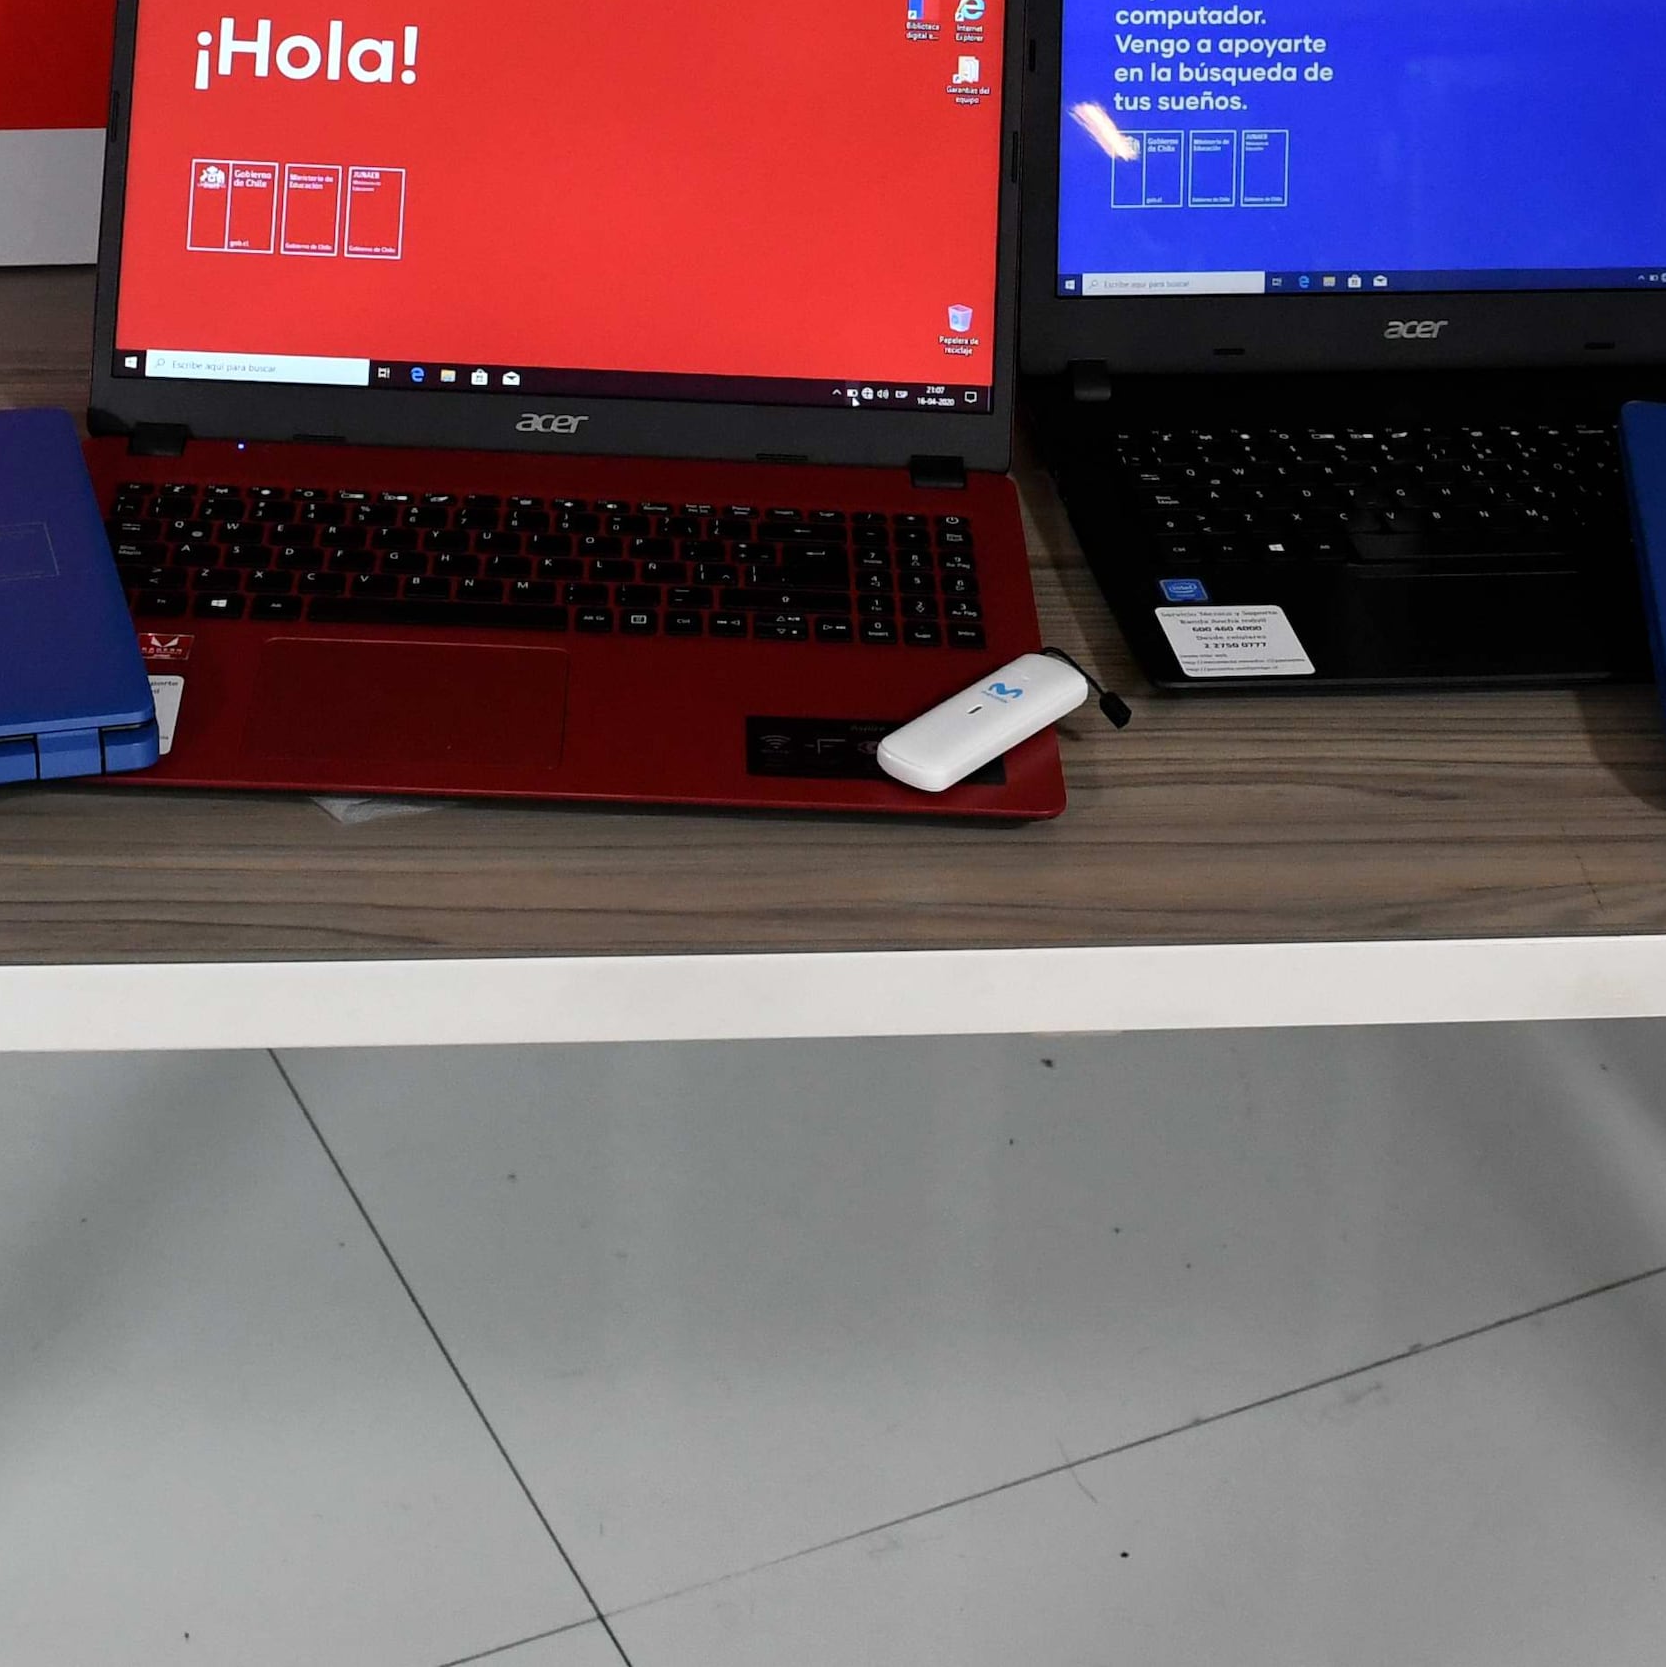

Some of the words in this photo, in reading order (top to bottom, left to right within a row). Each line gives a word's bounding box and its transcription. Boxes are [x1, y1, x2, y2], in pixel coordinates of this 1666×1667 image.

[1115, 5, 1266, 29] computador.
[906, 22, 940, 30] Biblioteca
[957, 24, 983, 32] Internet
[956, 34, 983, 42] Explorer
[1114, 34, 1190, 58] Vengo
[1196, 38, 1211, 54] a
[1218, 35, 1326, 58] apoyarte
[194, 16, 420, 90] ¡Hola!
[1114, 67, 1143, 82] en
[1150, 62, 1171, 82] la
[1179, 62, 1297, 86] búsqueda
[1304, 62, 1333, 82] de
[979, 87, 990, 95] del
[1114, 93, 1151, 111] tus
[1157, 91, 1248, 111] sueños.
[234, 169, 272, 180] Gobierno
[233, 179, 244, 188] de
[245, 179, 267, 188] Chile
[1383, 318, 1448, 340] acer
[939, 336, 969, 345] Papelera
[970, 337, 979, 345] de
[945, 346, 973, 355] reciclaje
[172, 360, 203, 370] Escribe
[226, 364, 246, 373] para
[248, 363, 277, 373] buscar
[514, 412, 589, 436] acer
